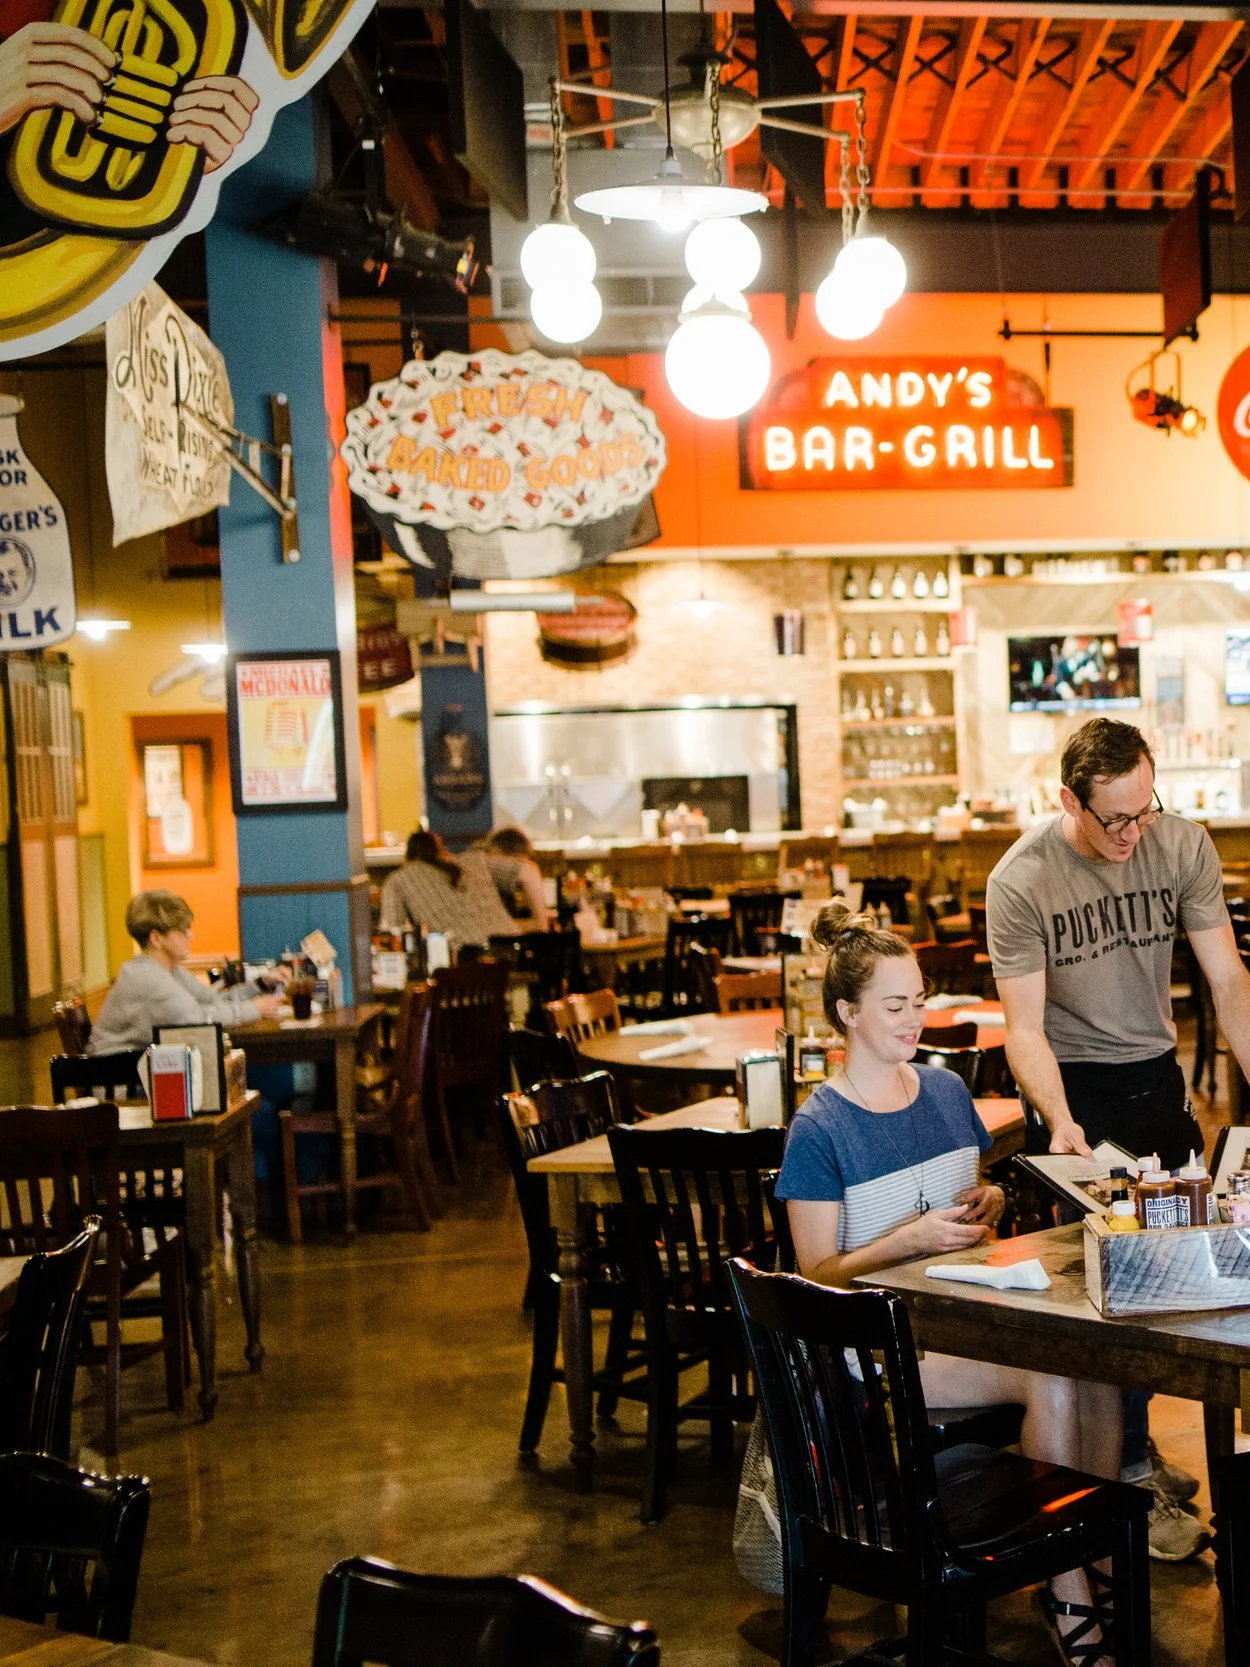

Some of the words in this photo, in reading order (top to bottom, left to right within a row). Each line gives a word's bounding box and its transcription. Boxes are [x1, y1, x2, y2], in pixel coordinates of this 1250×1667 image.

[429, 382, 588, 431] FRESH
[826, 366, 992, 408] ANDY'S
[385, 433, 512, 493] BAKED
[524, 432, 646, 490] GOODS
[766, 424, 1055, 472] BAR-GRILL
[1052, 888, 1176, 954] PUCKETT'S
